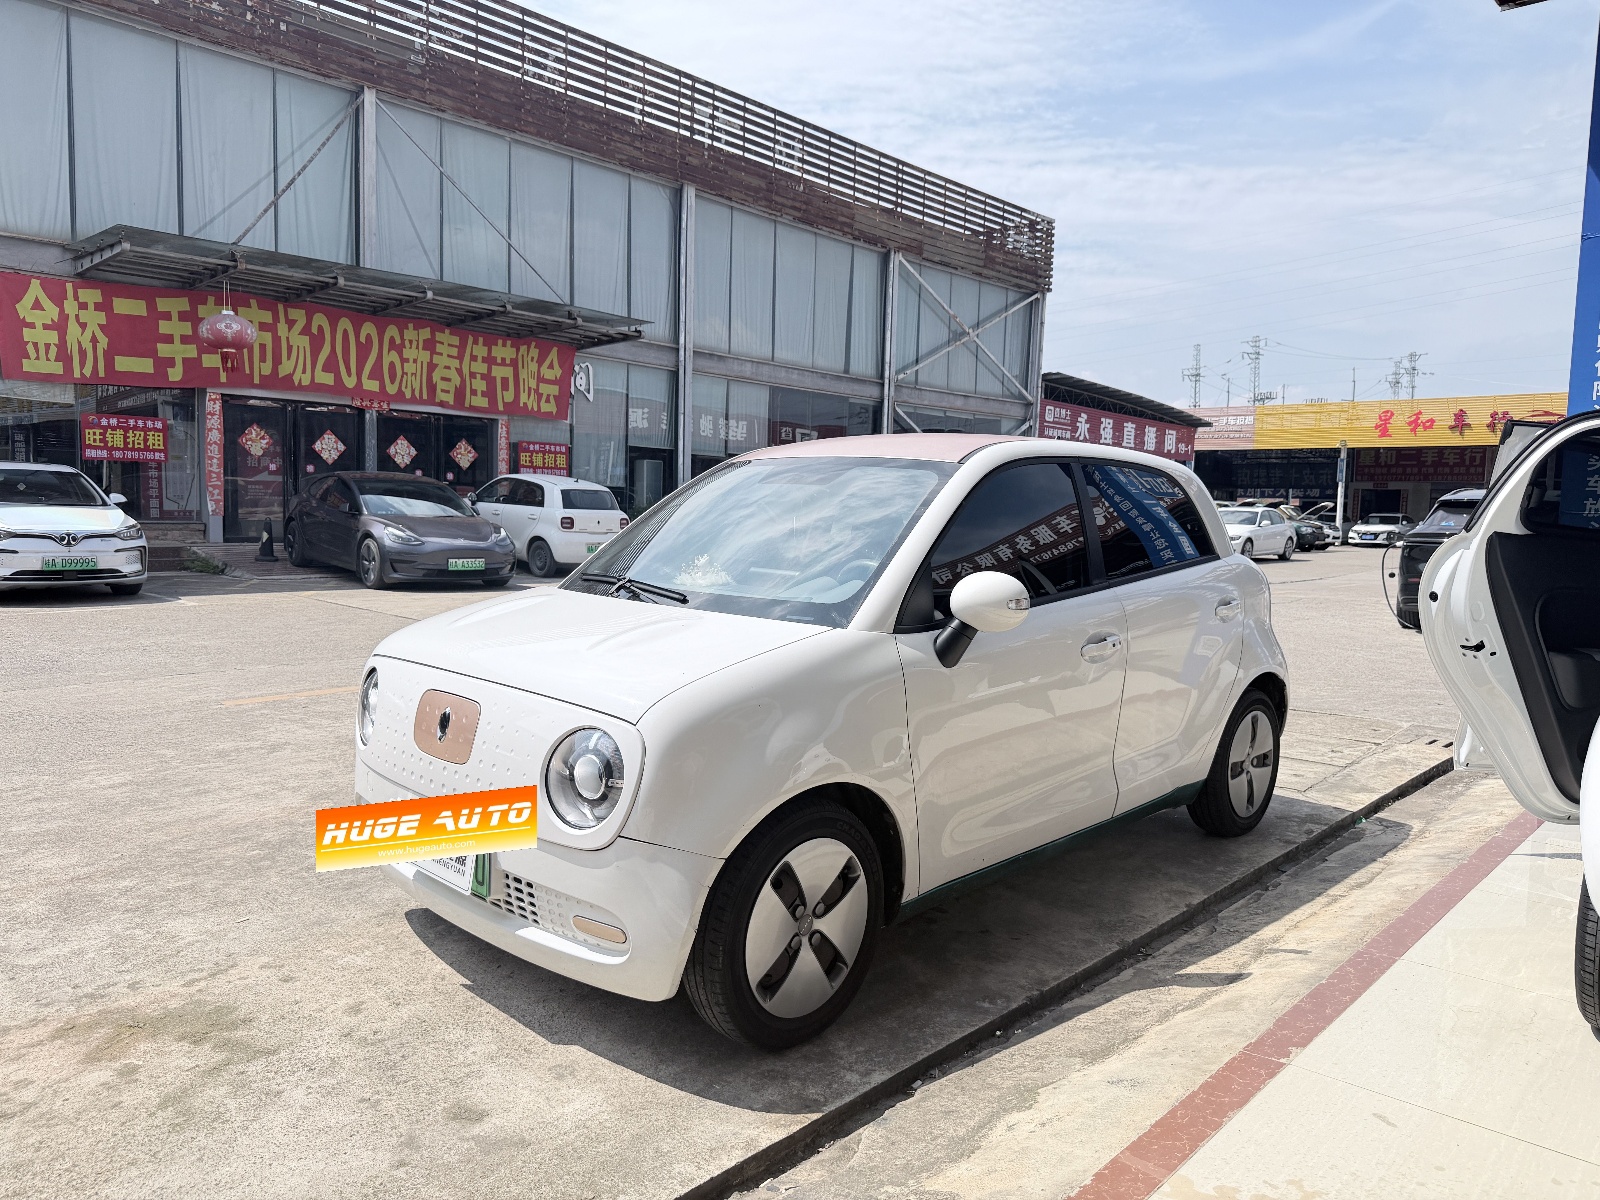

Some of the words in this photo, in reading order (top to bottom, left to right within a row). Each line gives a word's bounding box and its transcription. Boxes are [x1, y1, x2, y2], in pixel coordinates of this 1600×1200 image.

[100, 417, 163, 429] 金桥二手车市场
[85, 428, 165, 449] 旺铺招租
[1075, 412, 1177, 454] 永强直播间
[1177, 442, 1192, 455] 19-1
[520, 452, 567, 468] 旺铺招租
[1358, 449, 1483, 466] 星和二手车行
[61, 557, 96, 568] D99995
